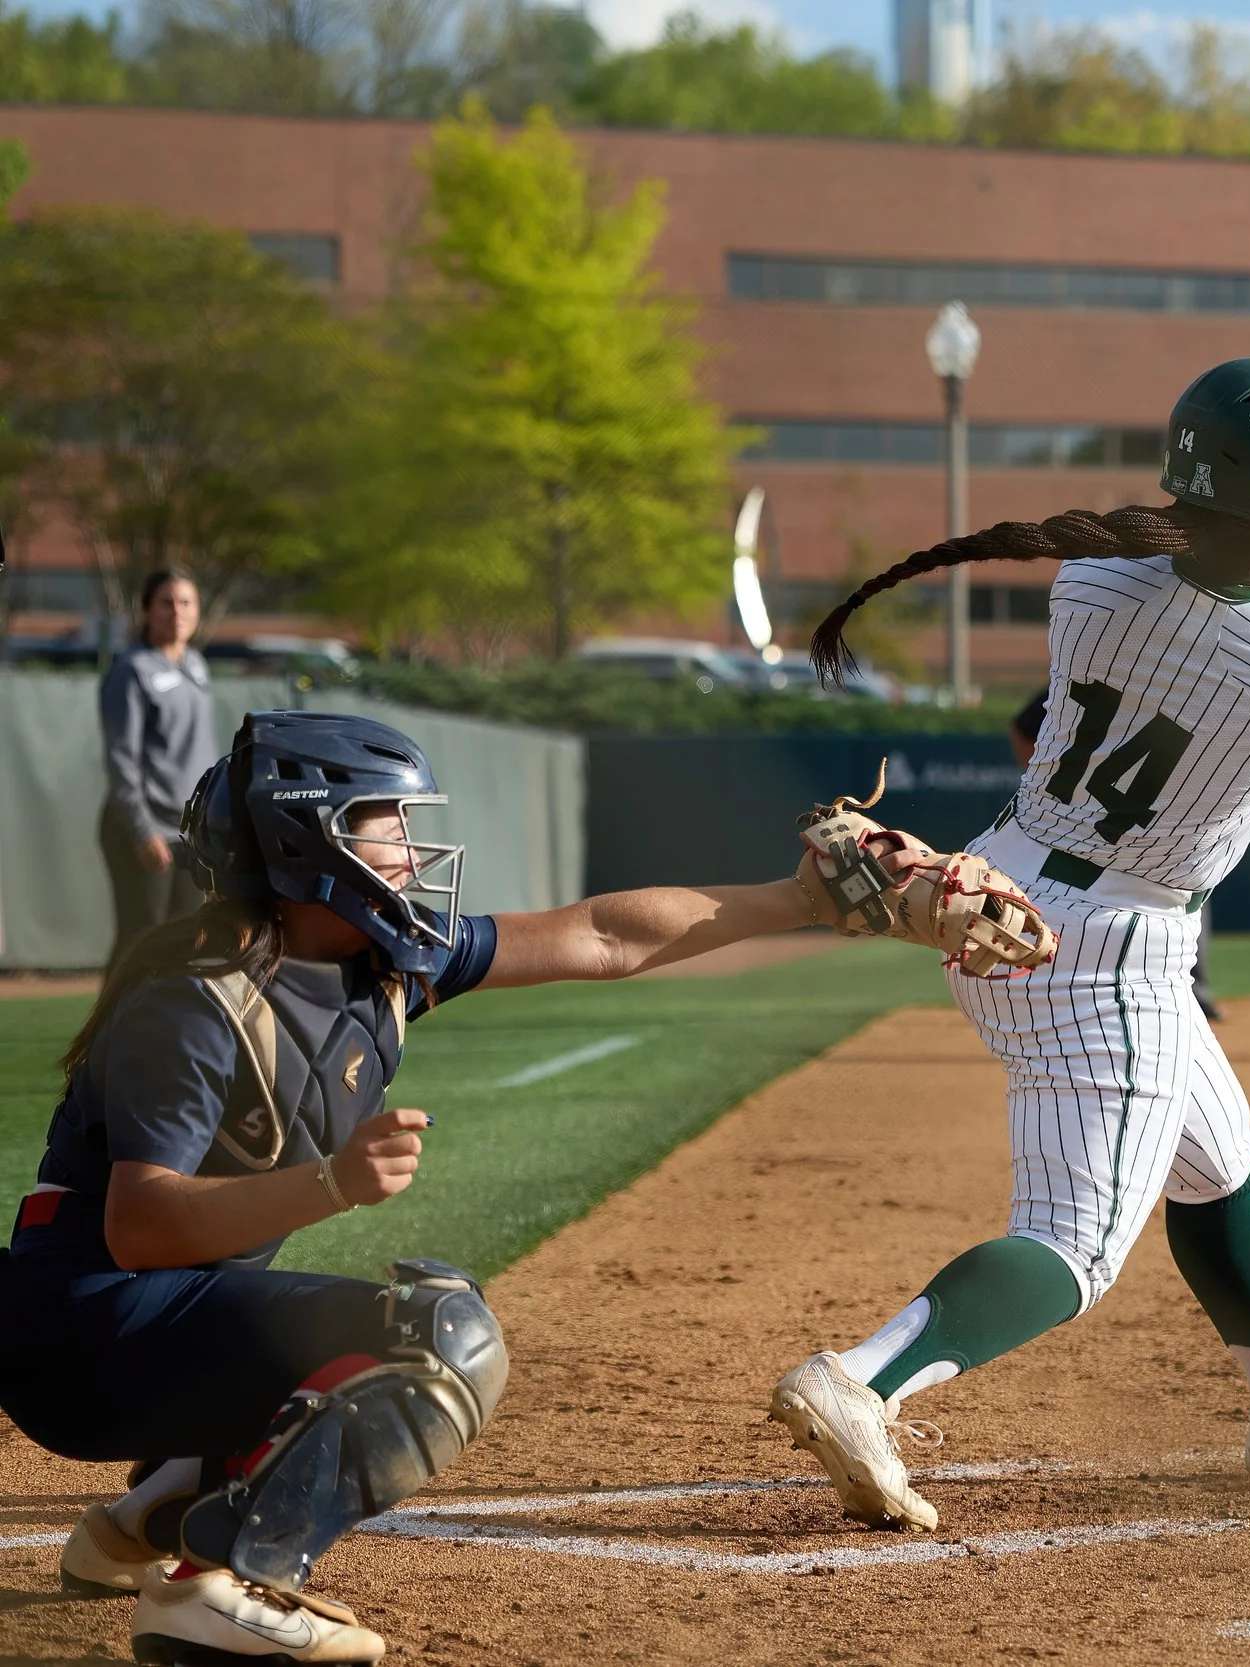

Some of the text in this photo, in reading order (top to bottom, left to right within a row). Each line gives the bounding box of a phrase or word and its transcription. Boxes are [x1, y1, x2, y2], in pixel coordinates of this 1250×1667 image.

[1178, 427, 1195, 453] 14
[1045, 679, 1194, 844] 14
[272, 788, 329, 800] EASTON
